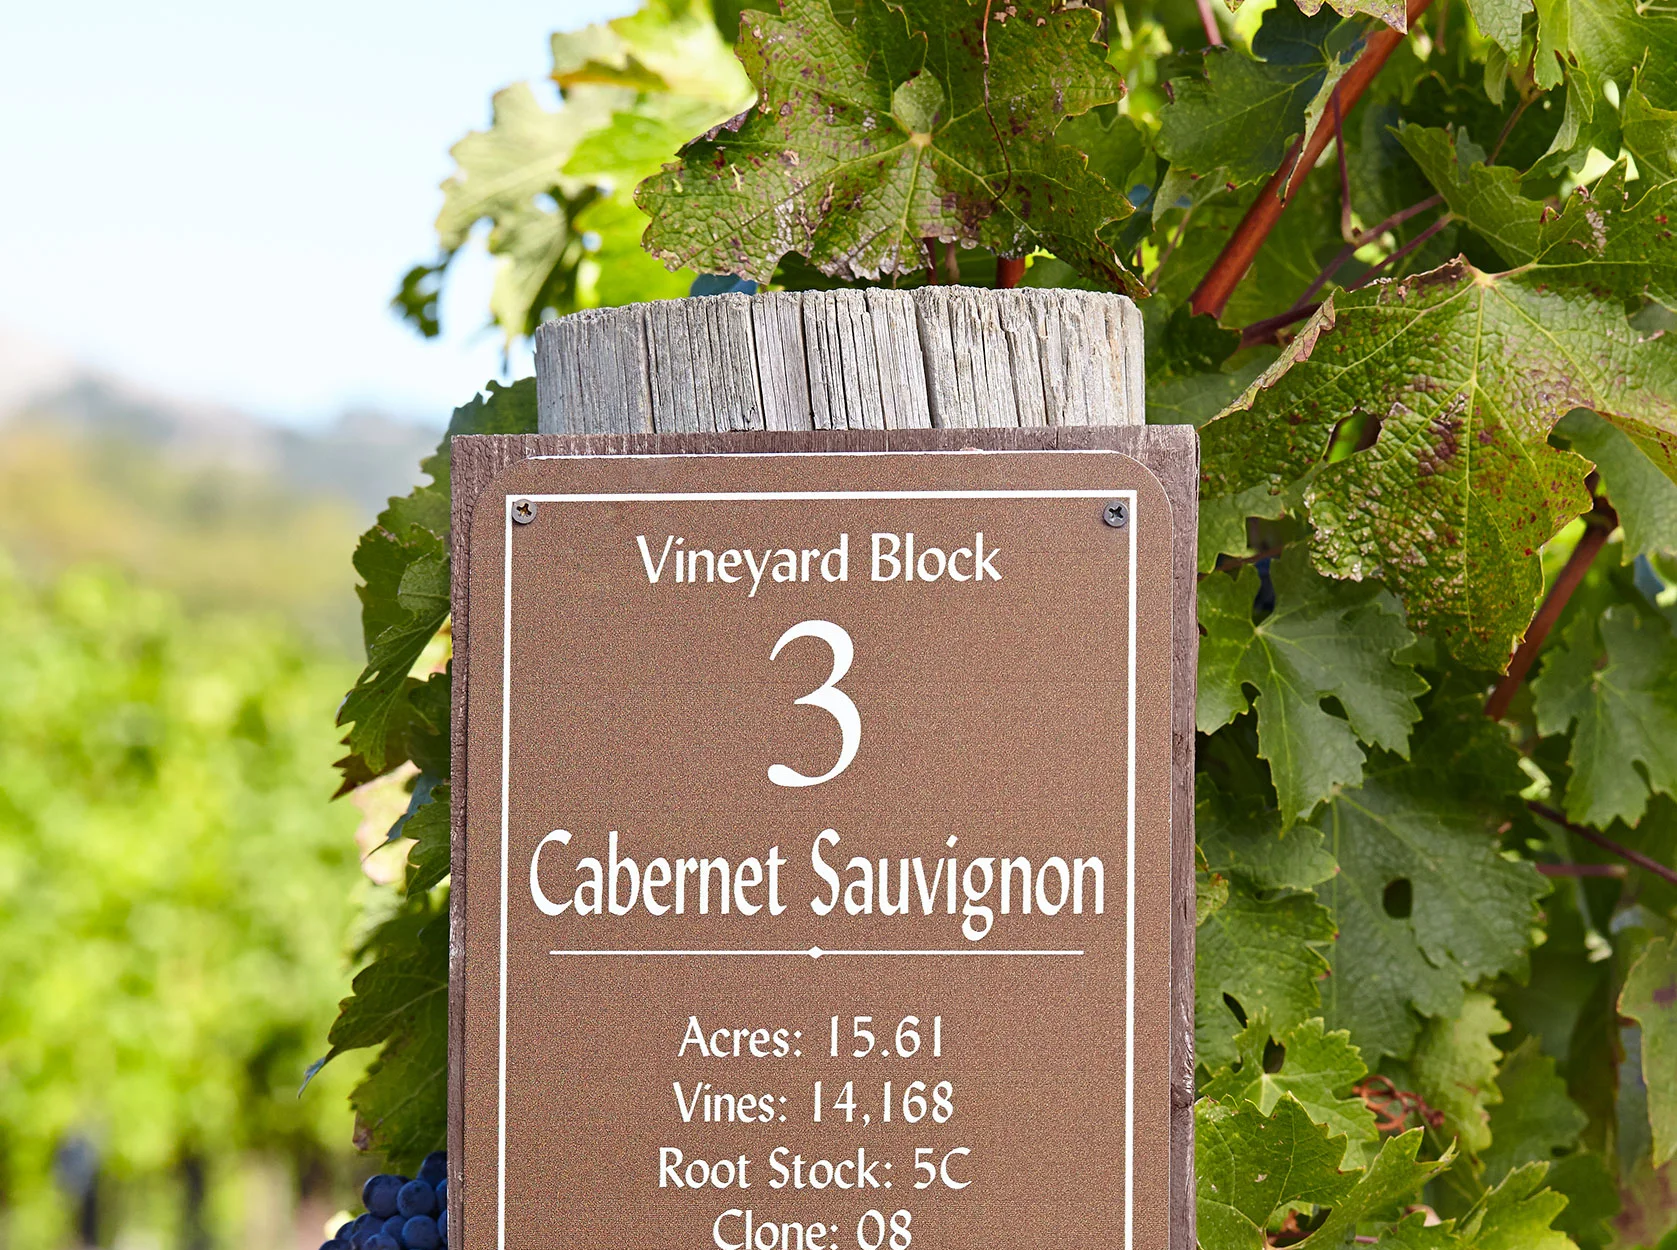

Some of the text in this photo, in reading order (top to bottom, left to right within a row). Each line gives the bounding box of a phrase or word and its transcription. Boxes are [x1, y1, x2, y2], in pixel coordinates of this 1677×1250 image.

[635, 531, 1003, 598] Vineyard Block
[767, 619, 862, 788] 3
[529, 828, 1105, 943] Cabernet Sauvignon
[677, 1015, 942, 1058] Acres: 15.61
[672, 1080, 954, 1128] Vines: 14,168
[659, 1146, 972, 1190] Root Stock: 5C
